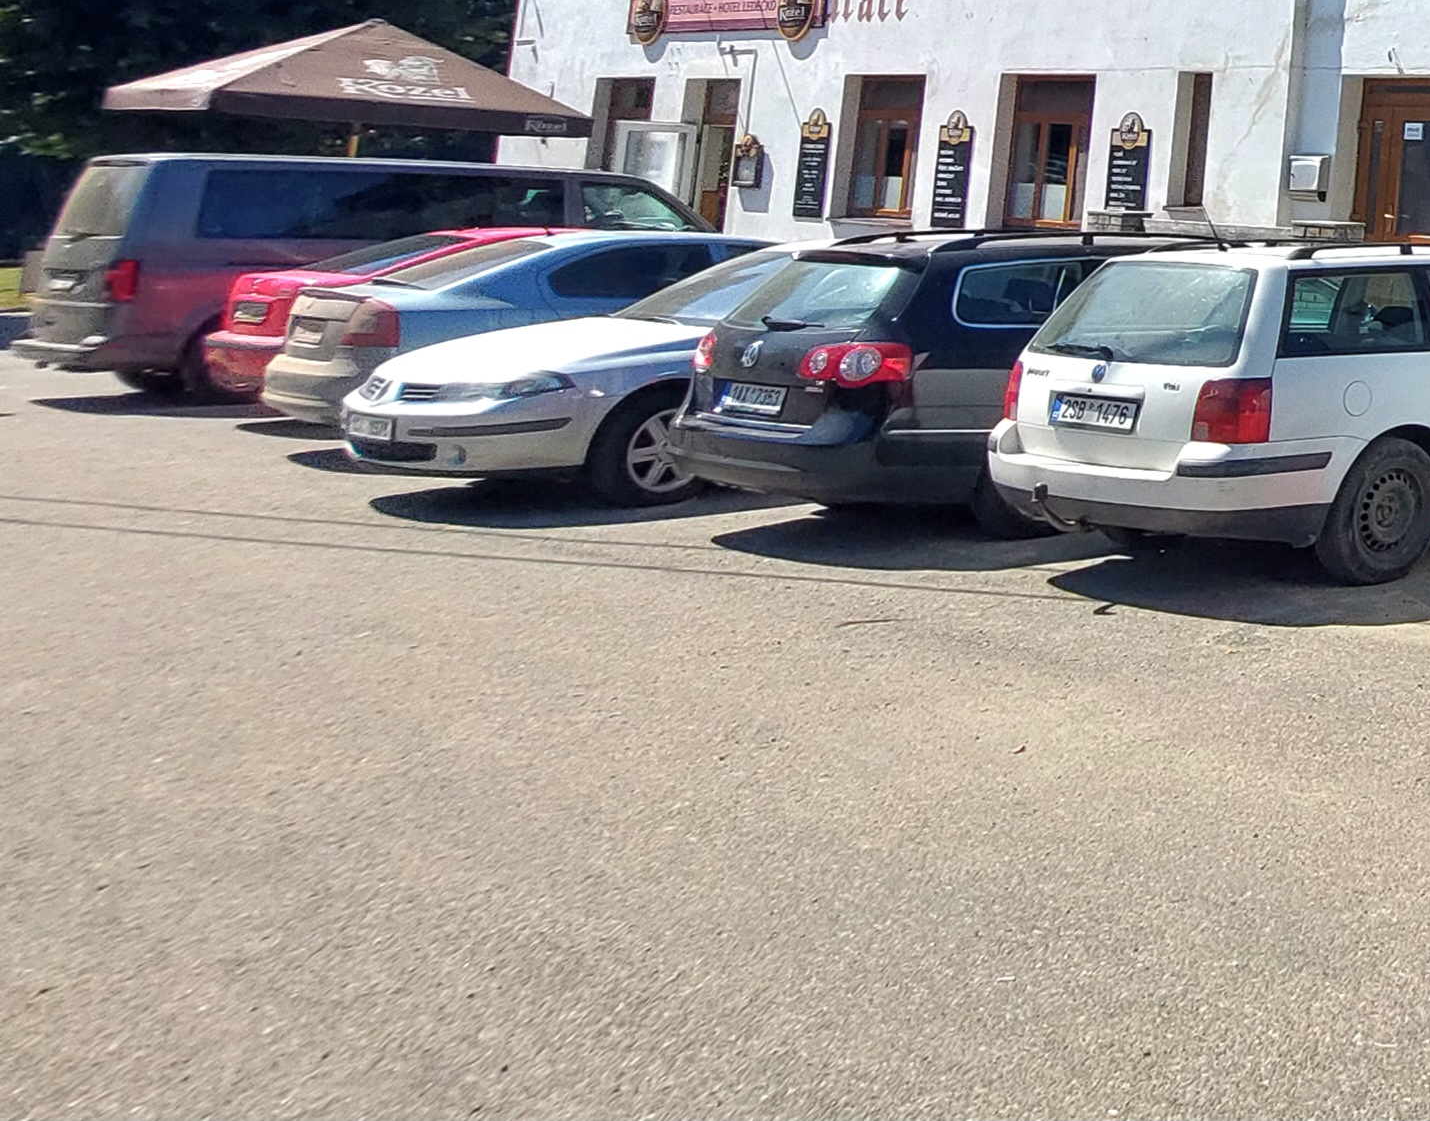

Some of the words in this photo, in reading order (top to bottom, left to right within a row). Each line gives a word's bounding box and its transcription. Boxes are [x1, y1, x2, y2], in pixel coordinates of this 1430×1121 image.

[780, 6, 805, 22] Kozel
[336, 77, 476, 103] Kozel
[1061, 398, 1086, 420] 2SB
[1095, 402, 1129, 426] 1476
